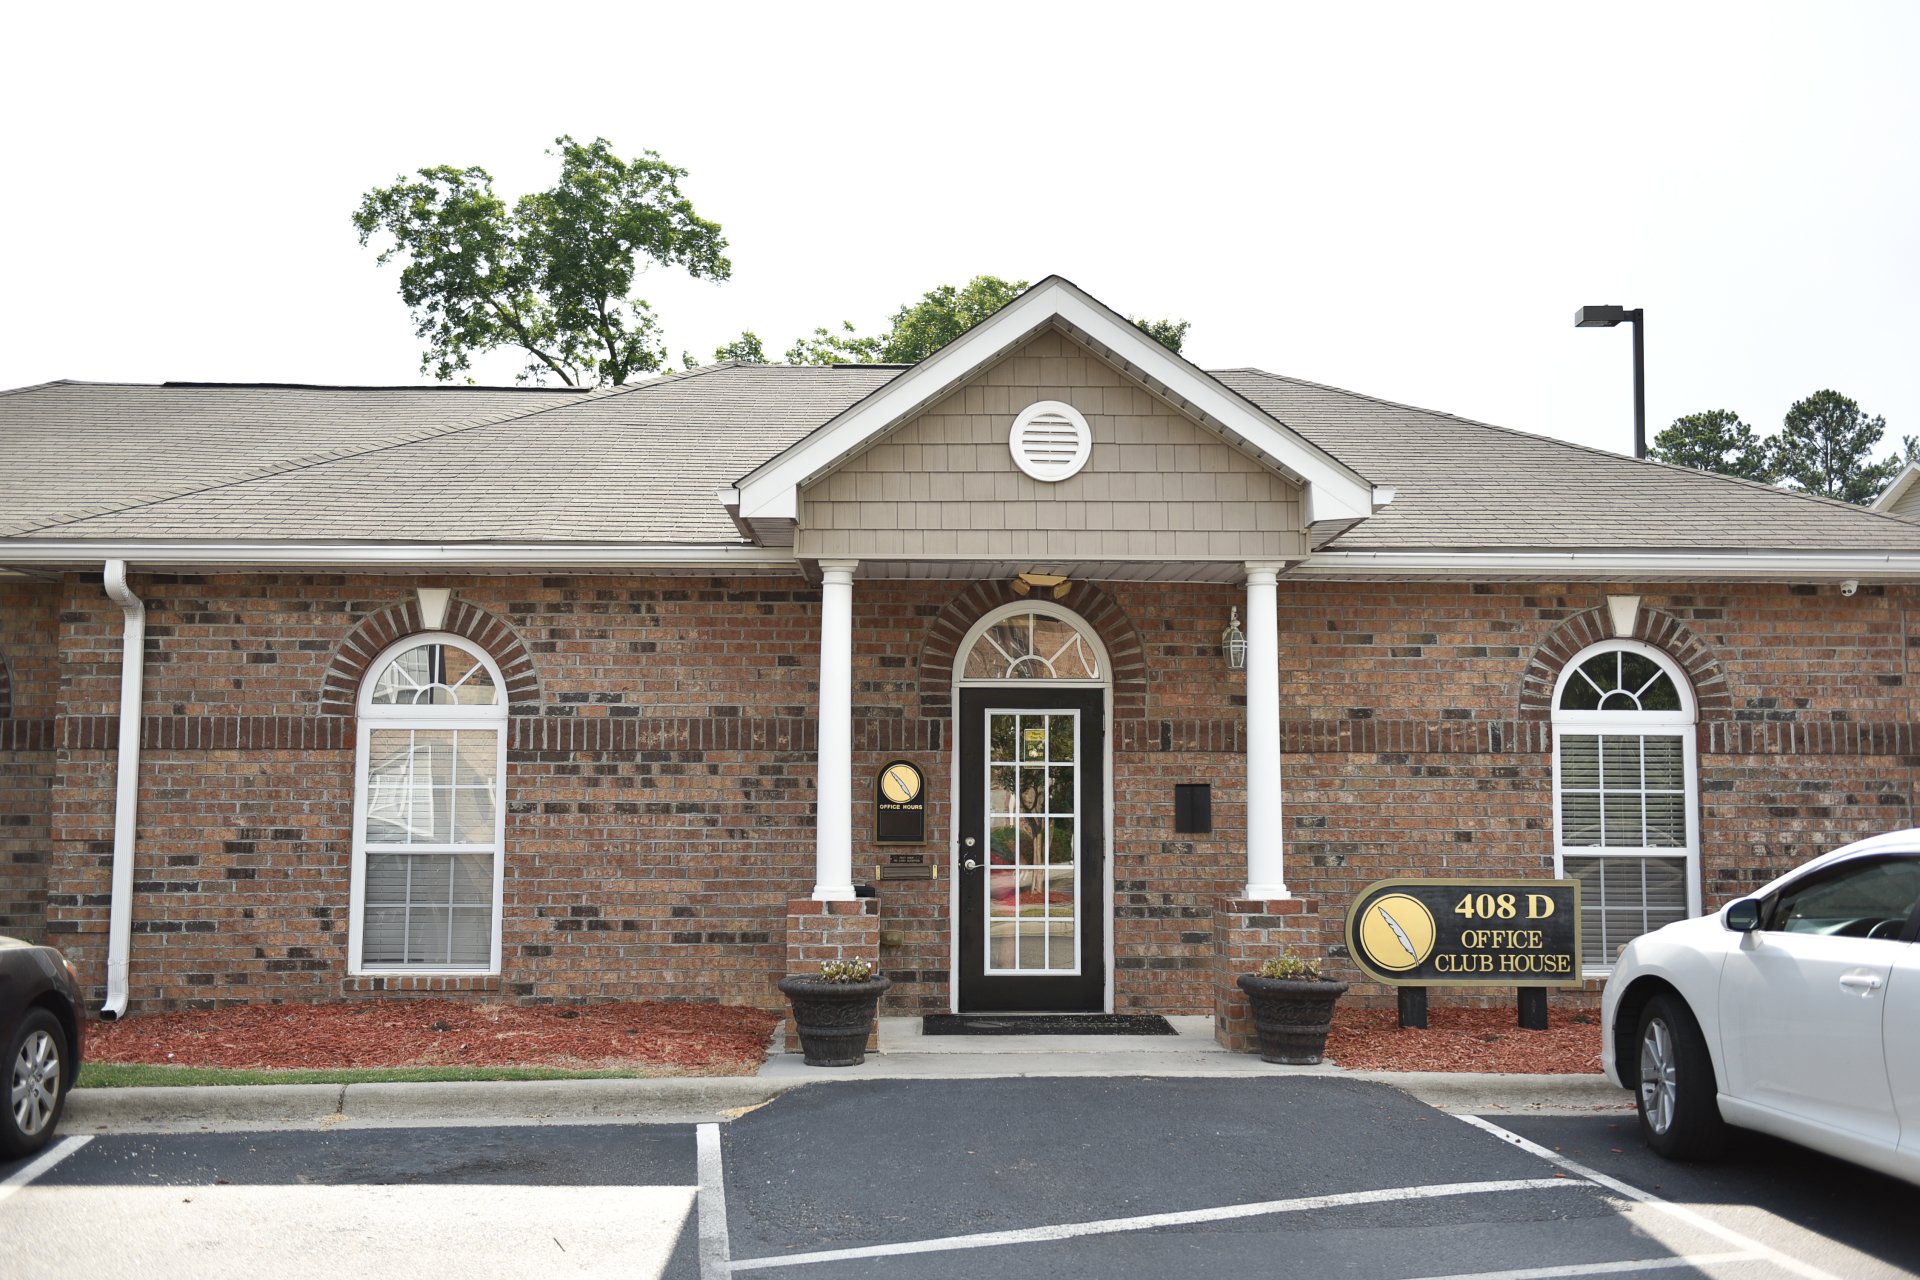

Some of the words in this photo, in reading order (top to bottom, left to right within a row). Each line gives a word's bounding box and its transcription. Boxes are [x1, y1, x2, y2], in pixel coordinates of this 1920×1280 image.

[1454, 893, 1516, 919] 408
[1525, 894, 1555, 919] D
[1461, 930, 1542, 949] OFFICE
[1434, 954, 1493, 972] CLUB
[1499, 954, 1571, 972] HOUSE
